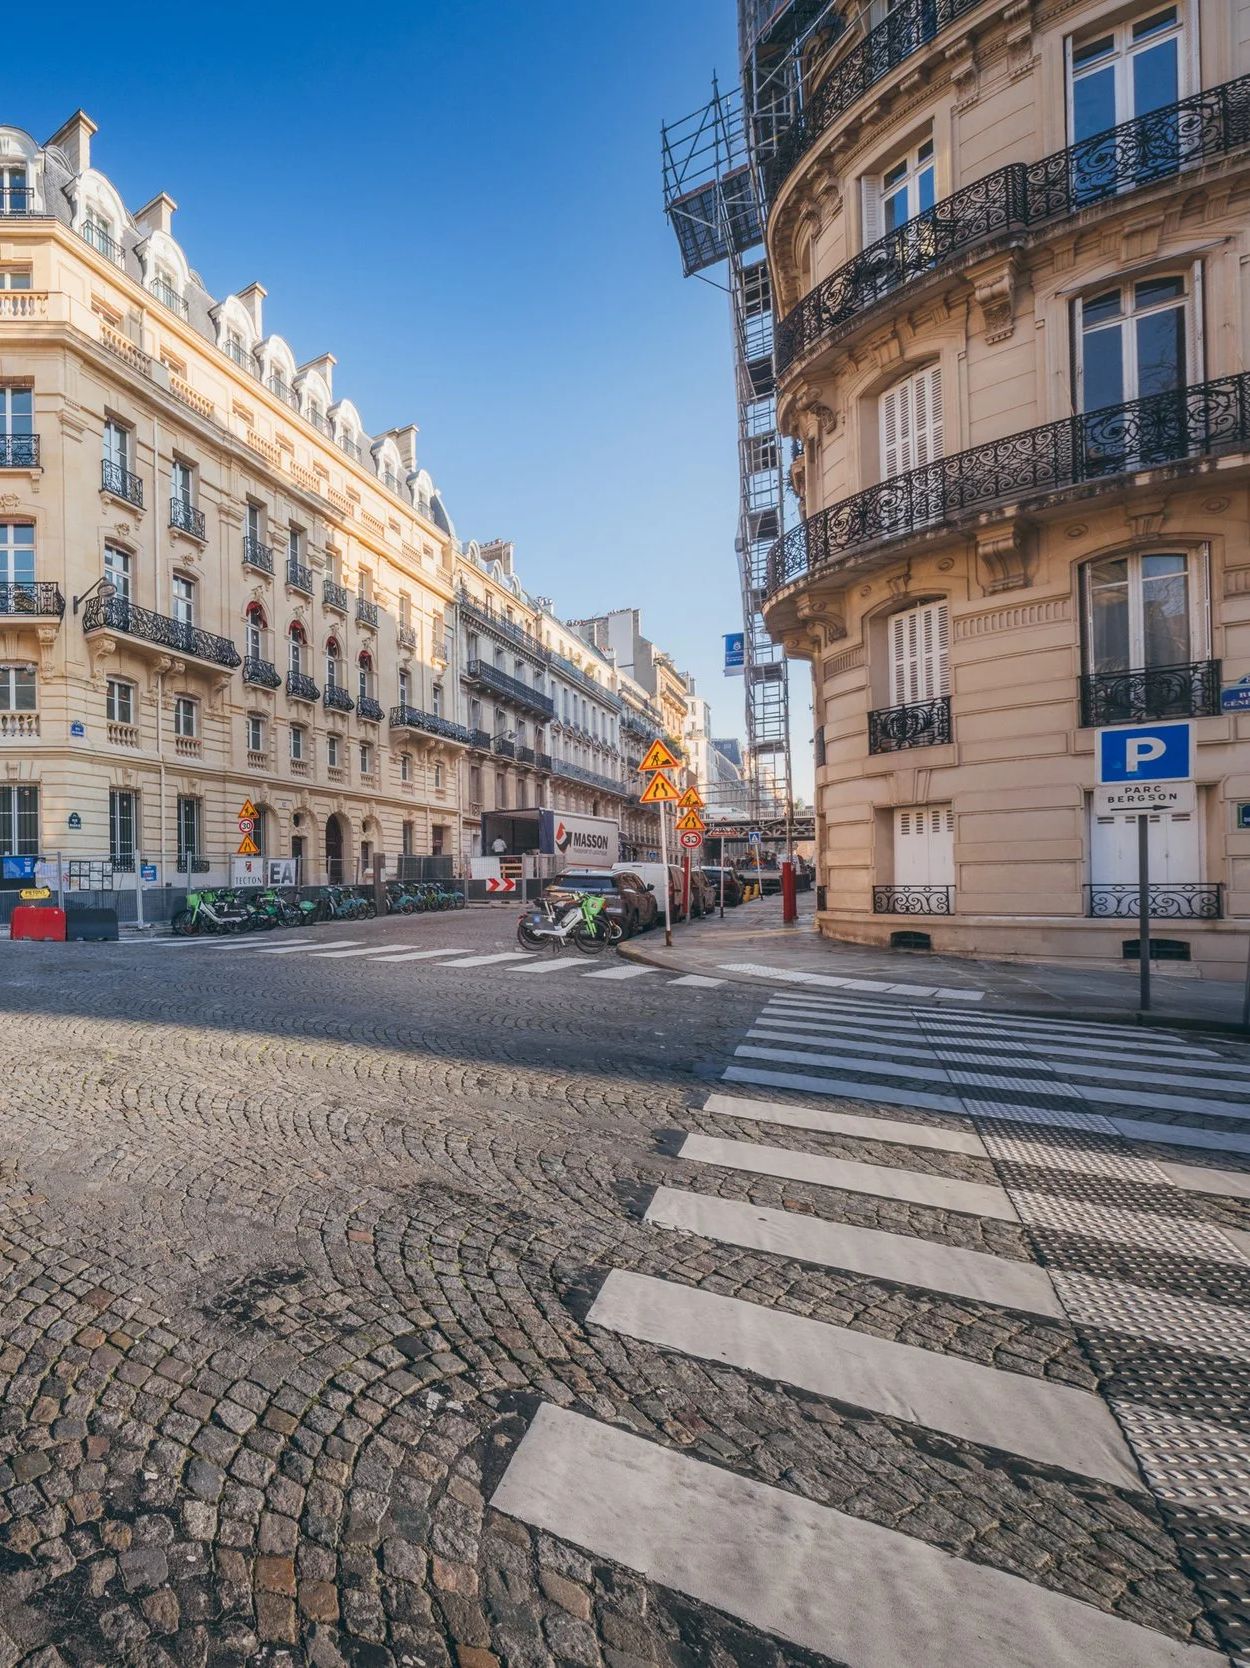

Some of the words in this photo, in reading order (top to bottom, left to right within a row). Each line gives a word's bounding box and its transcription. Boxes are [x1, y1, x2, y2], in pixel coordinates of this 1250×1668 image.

[1125, 736, 1167, 773] P
[1124, 785, 1162, 794] PARC
[1107, 793, 1178, 803] BERGSON
[573, 832, 609, 849] MASSON
[684, 835, 698, 844] 30
[270, 862, 293, 884] EA
[235, 876, 262, 885] TECTON
